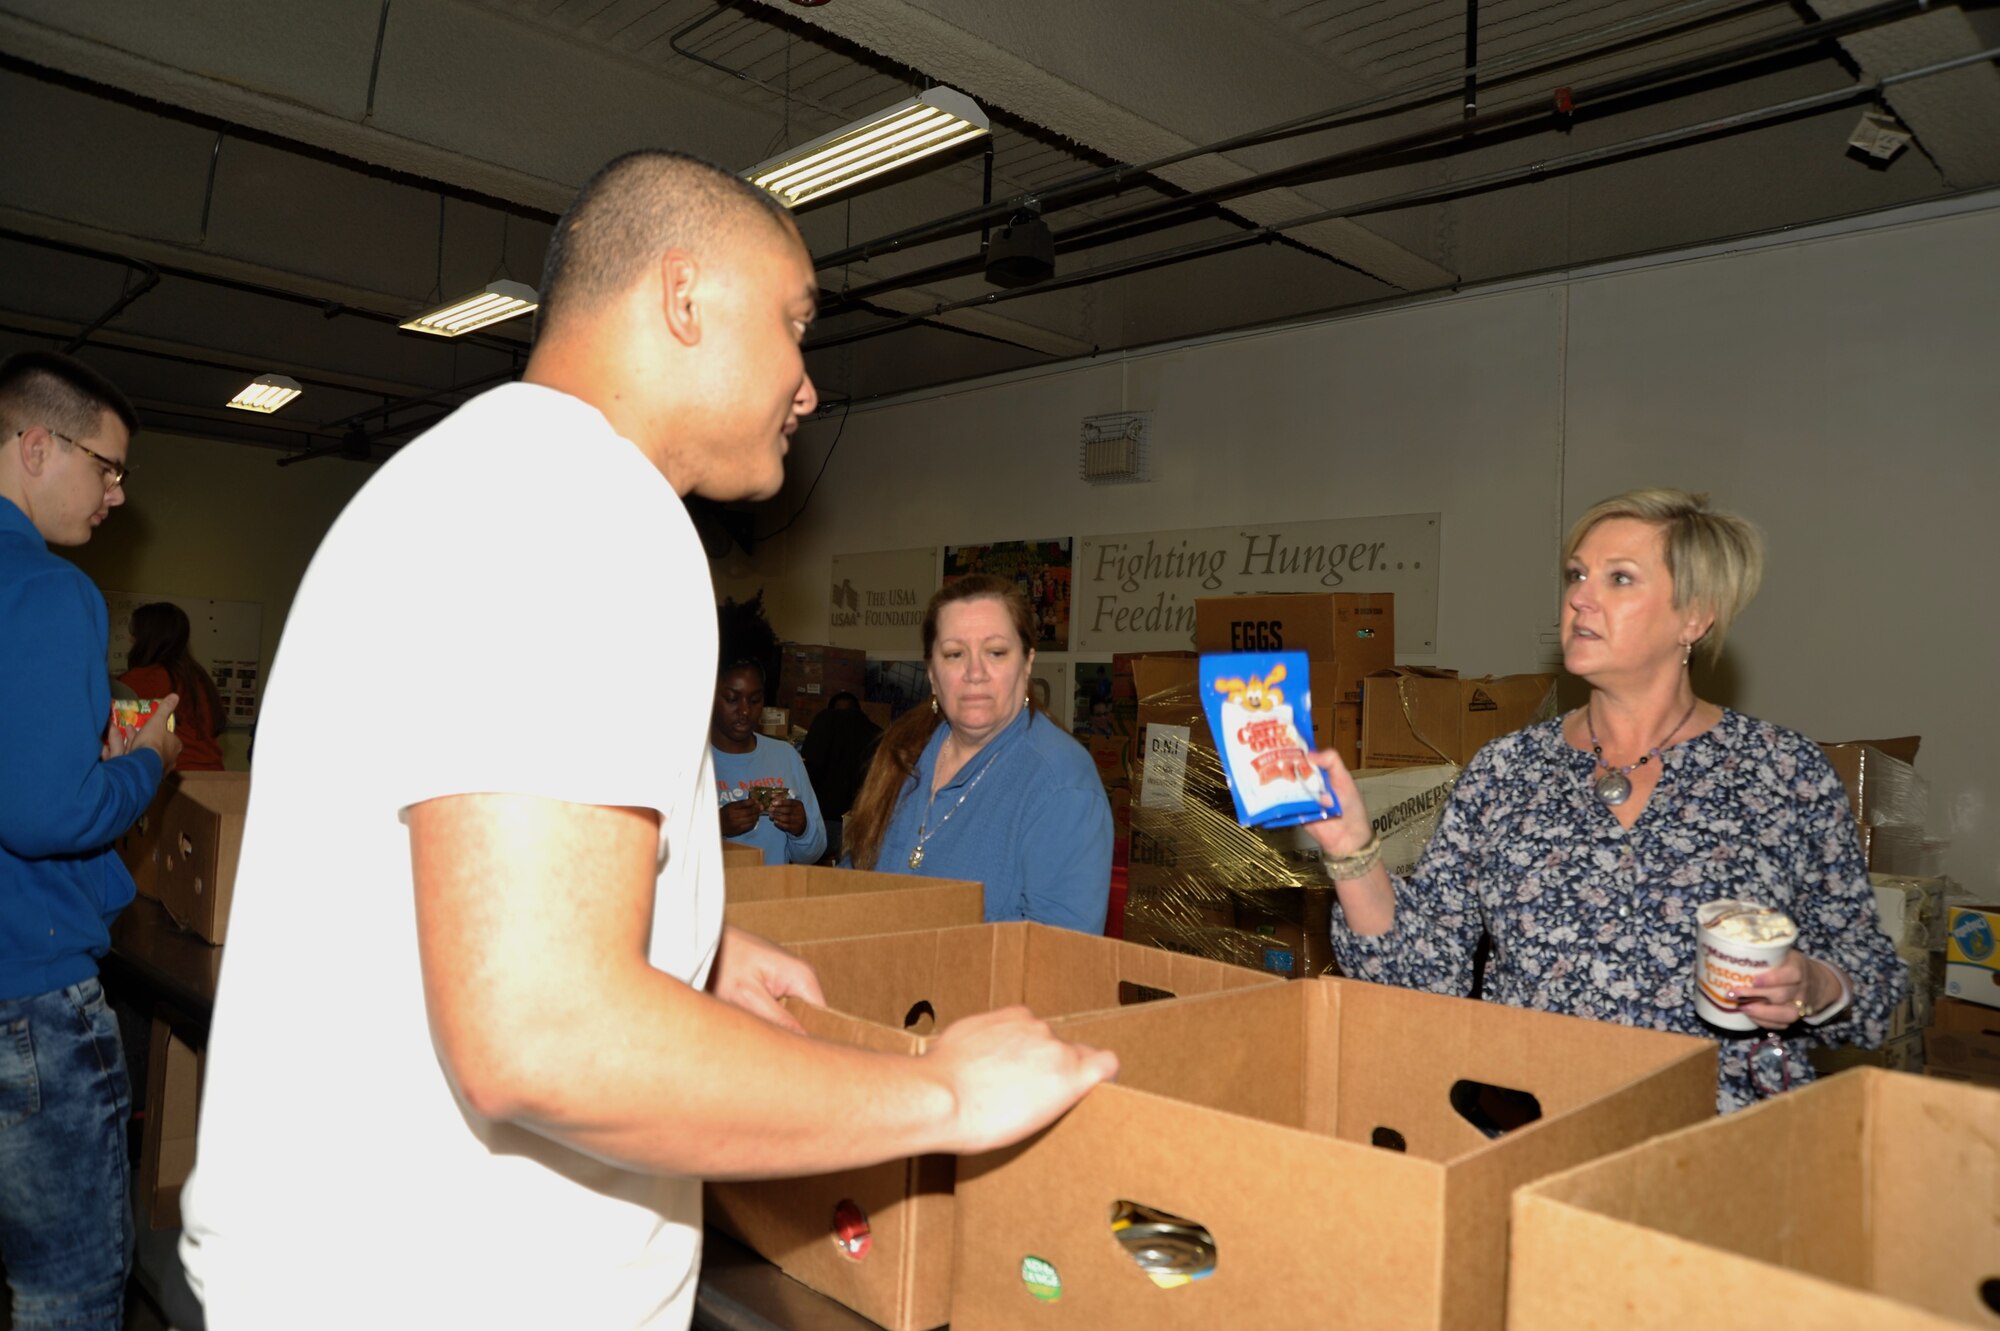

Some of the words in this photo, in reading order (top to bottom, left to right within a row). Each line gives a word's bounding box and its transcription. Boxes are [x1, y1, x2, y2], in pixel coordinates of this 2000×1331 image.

[1093, 539, 1227, 593] Fighting
[866, 589, 887, 607] THE
[888, 588, 917, 606] USAA
[864, 609, 925, 626] FOUNDATIO
[1091, 592, 1197, 644] Feedin
[1231, 620, 1283, 652] EGGS
[1372, 781, 1449, 833] POPCORNERS
[1704, 958, 1753, 983] Instan
